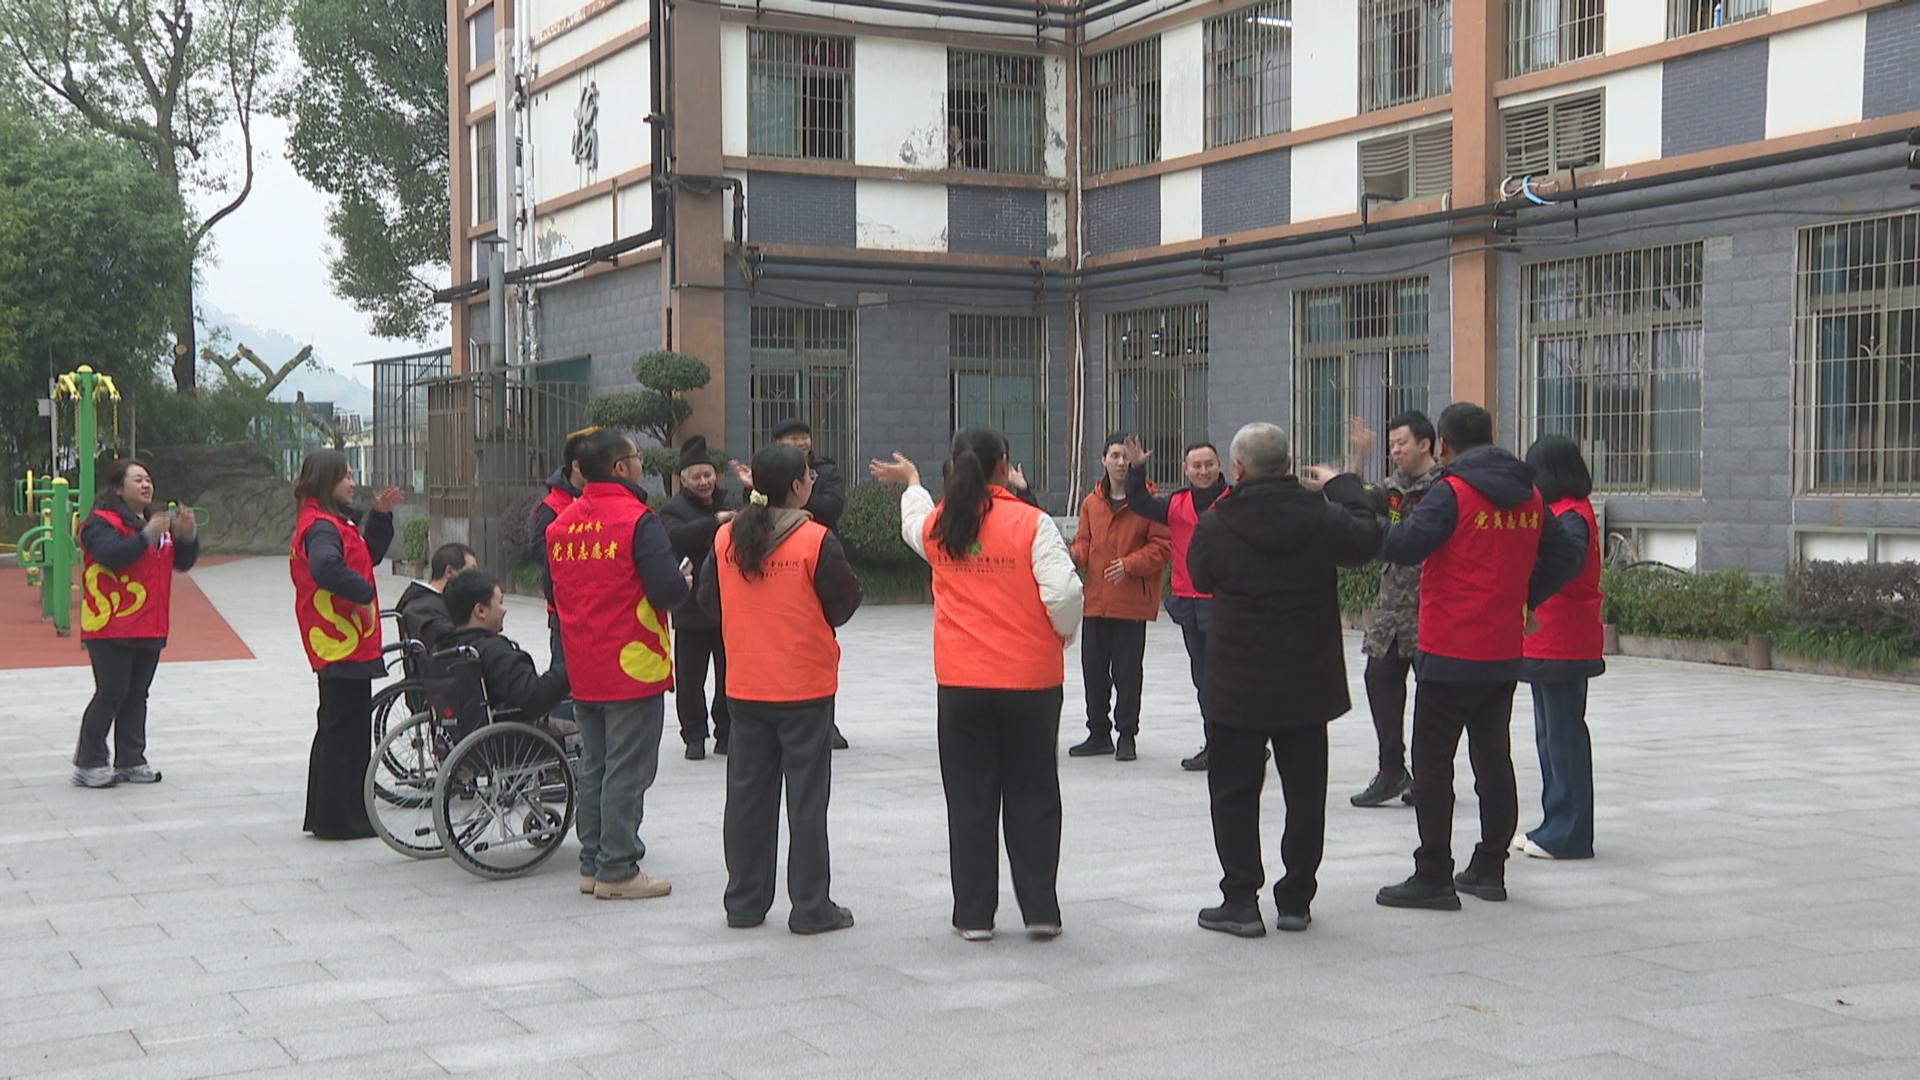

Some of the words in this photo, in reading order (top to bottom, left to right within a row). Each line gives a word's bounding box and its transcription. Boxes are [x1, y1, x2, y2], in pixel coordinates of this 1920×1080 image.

[1474, 511, 1539, 530] 党员志愿者
[552, 540, 618, 562] 党员志愿者
